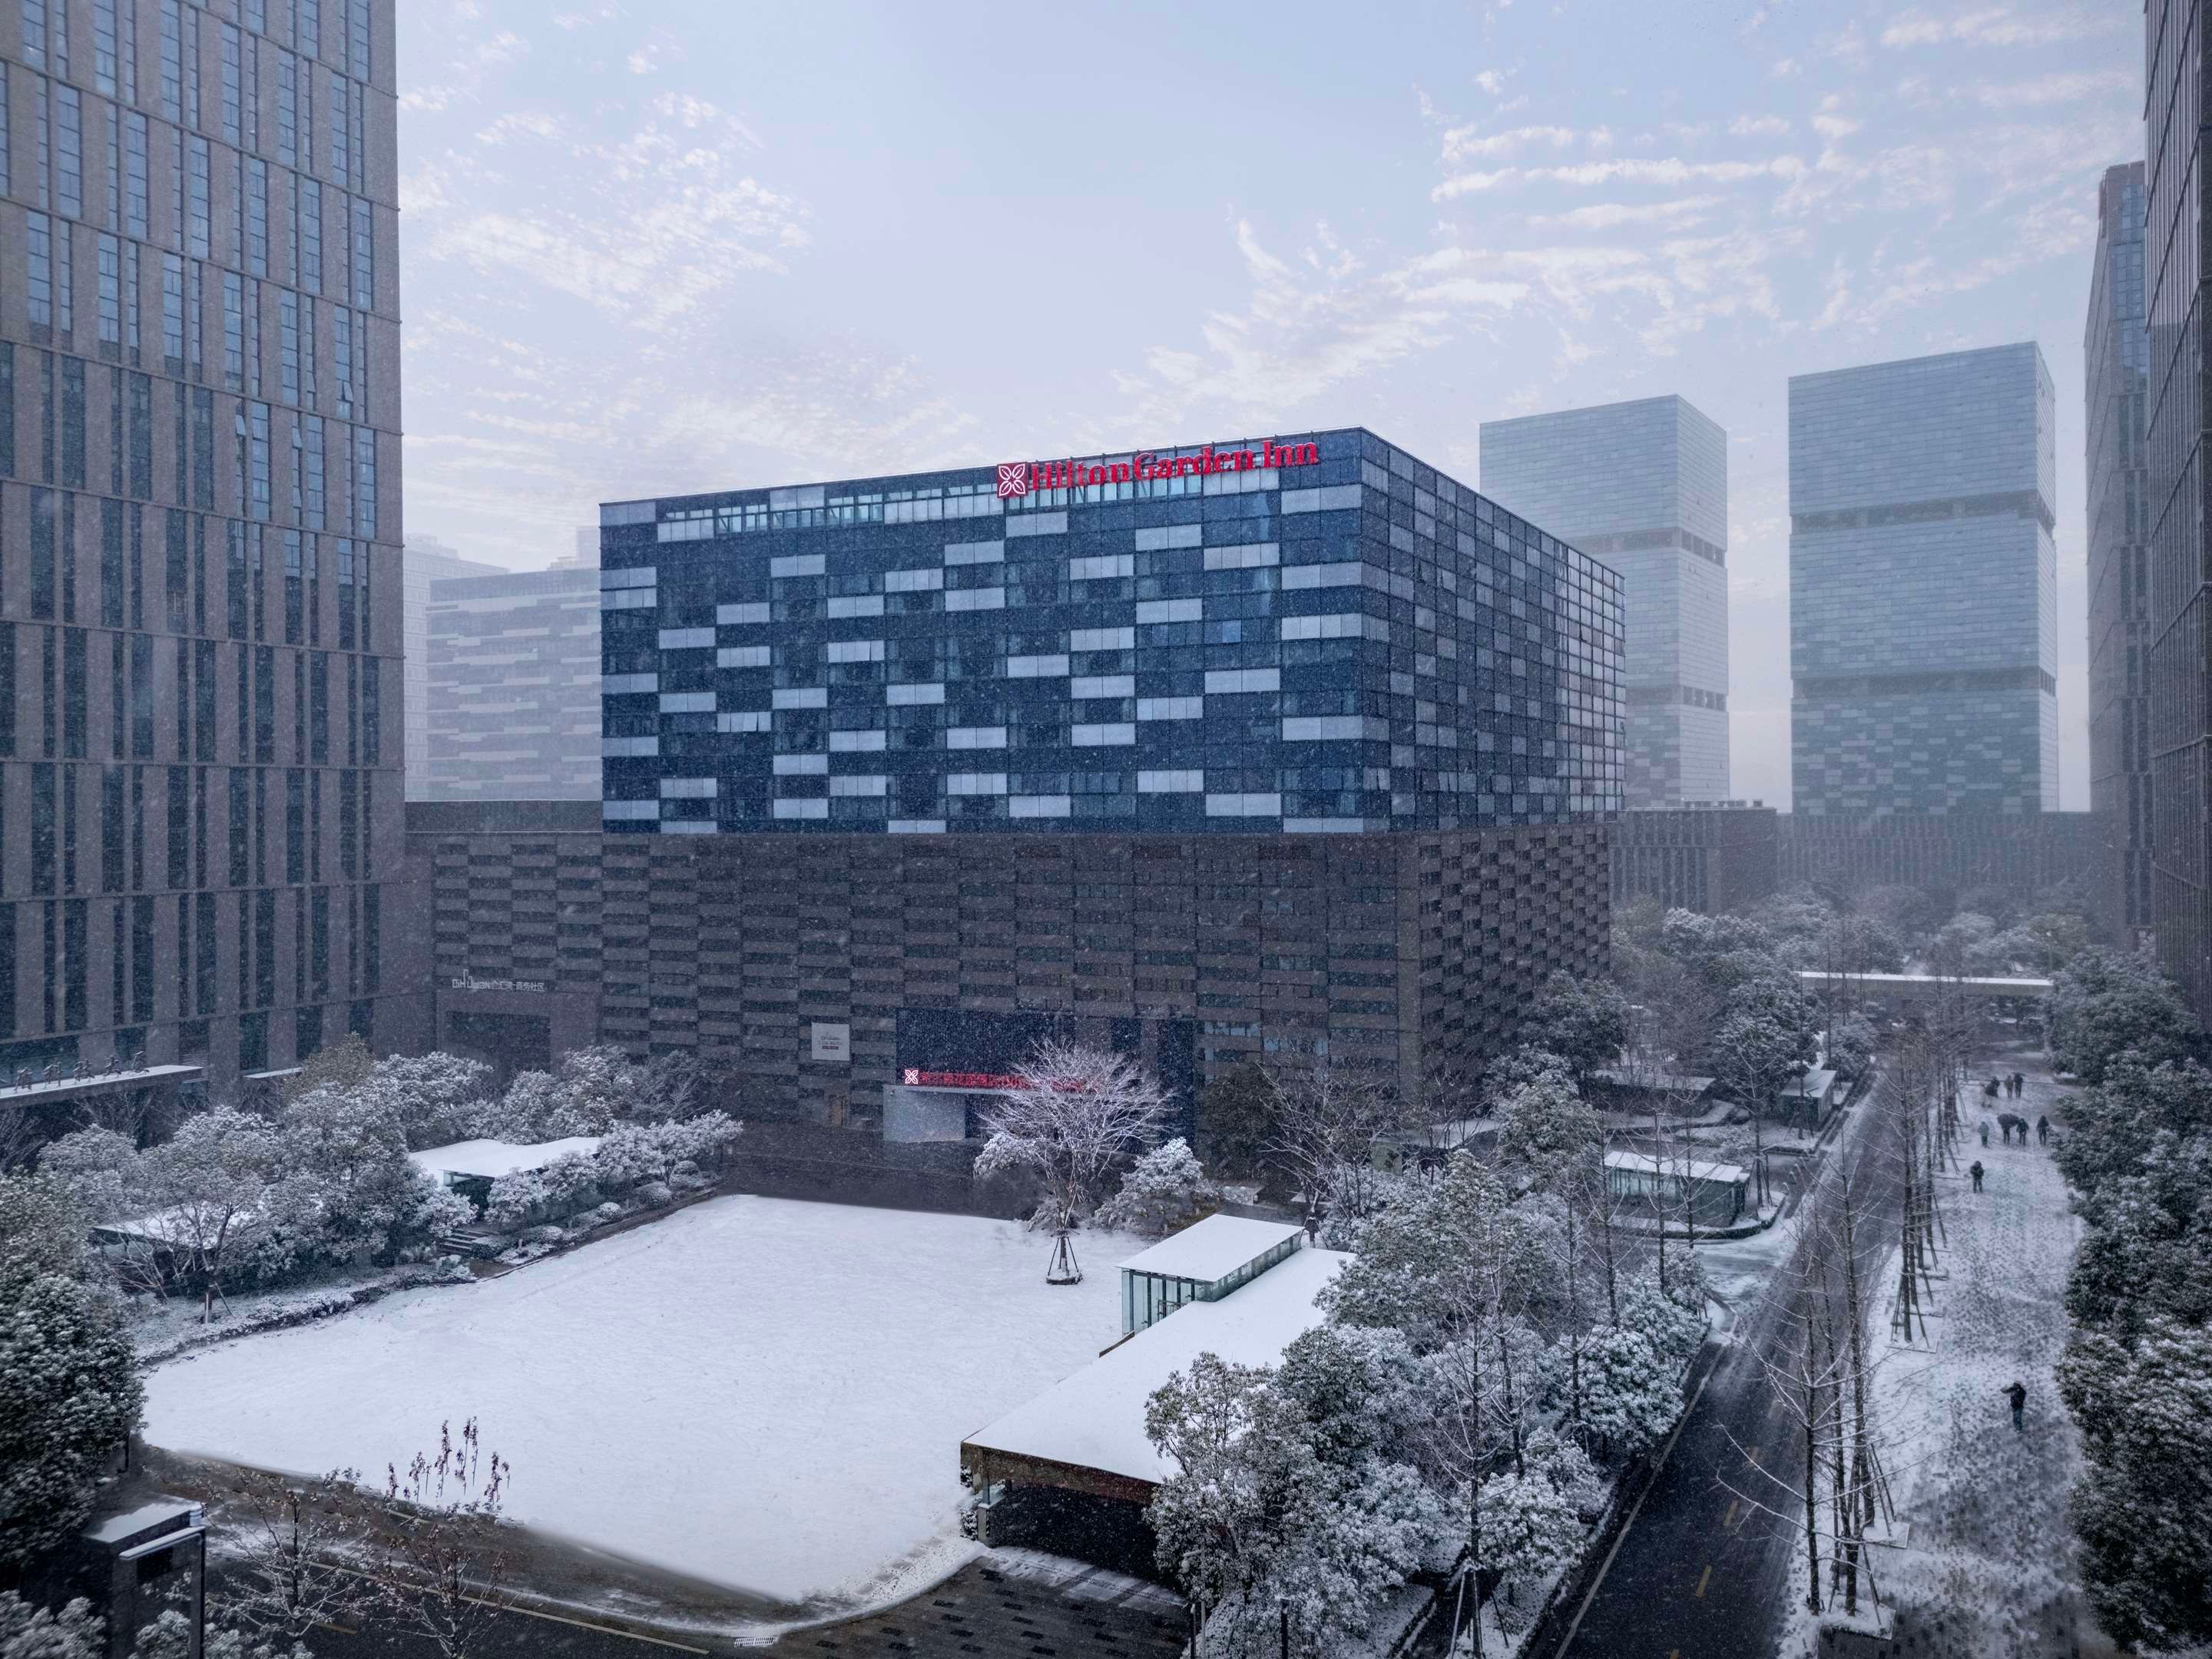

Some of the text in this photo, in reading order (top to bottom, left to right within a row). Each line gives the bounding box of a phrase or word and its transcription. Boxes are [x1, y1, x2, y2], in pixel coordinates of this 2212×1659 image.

[1031, 440, 1319, 491] Hilton Garden Inn
